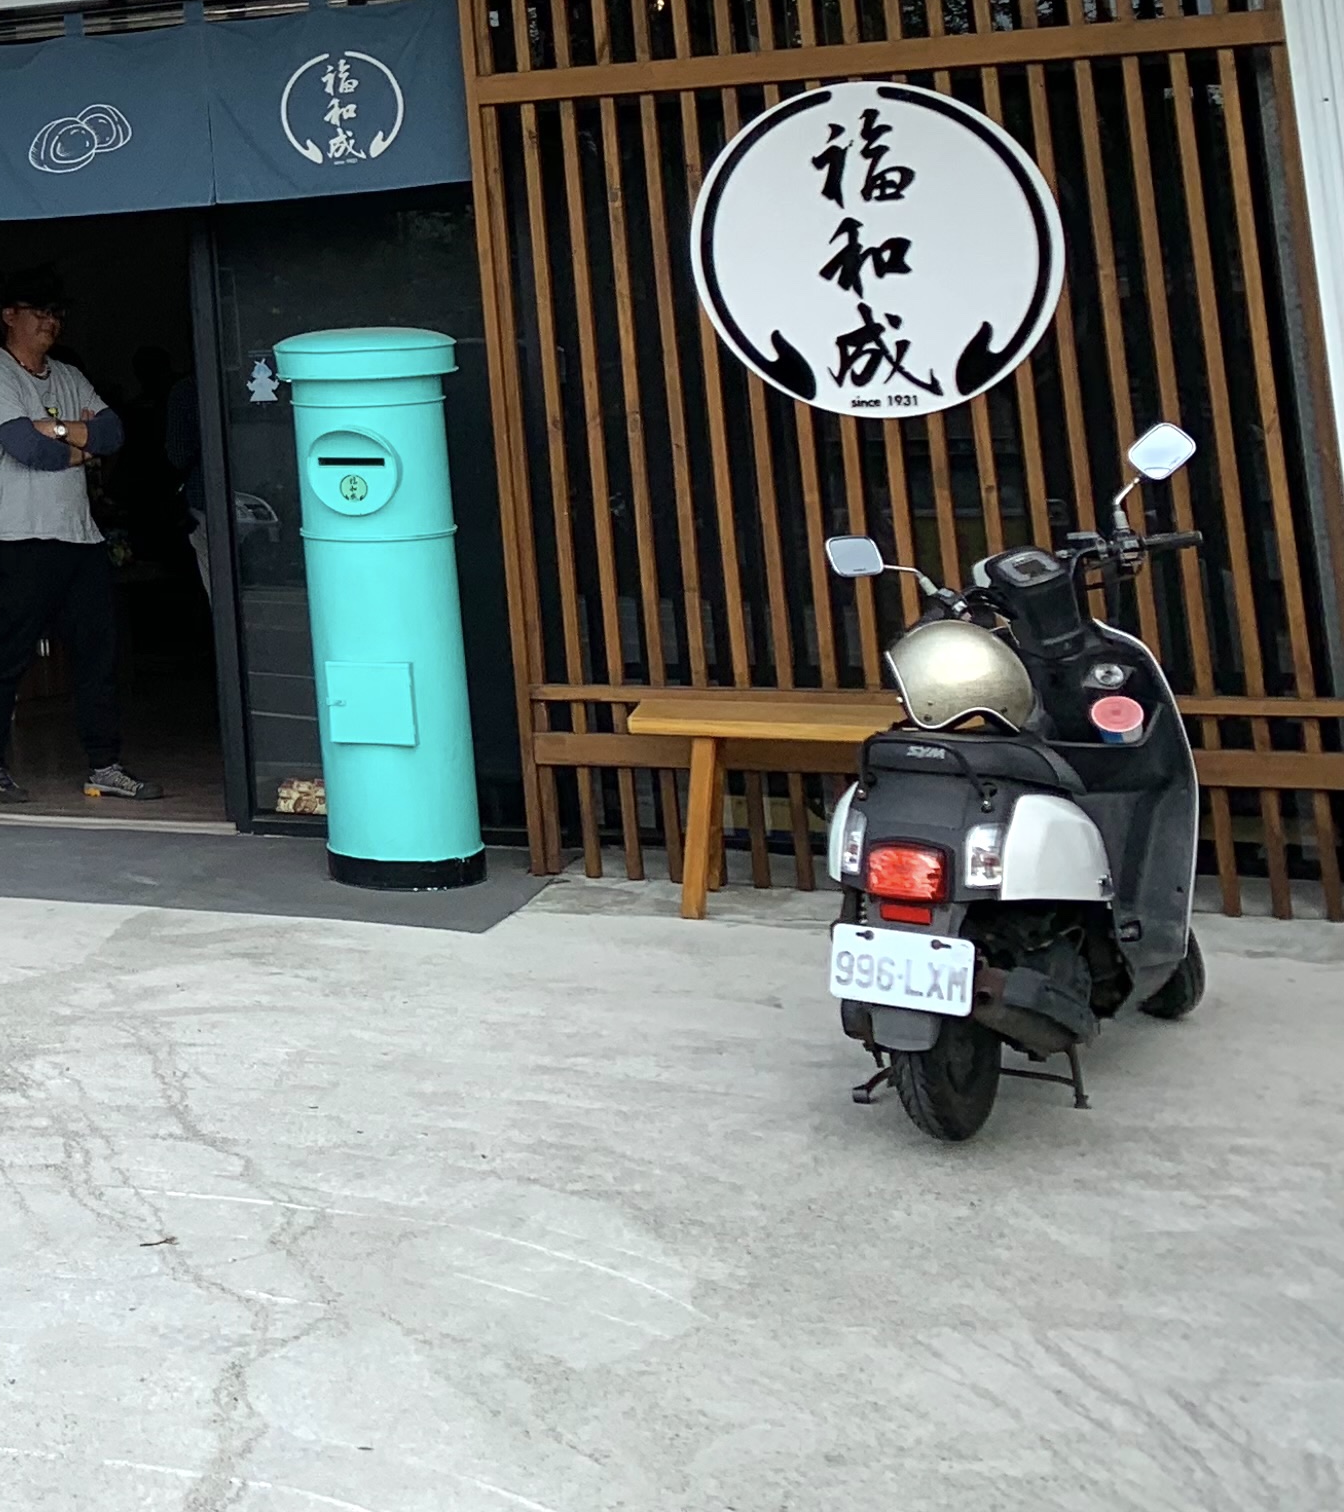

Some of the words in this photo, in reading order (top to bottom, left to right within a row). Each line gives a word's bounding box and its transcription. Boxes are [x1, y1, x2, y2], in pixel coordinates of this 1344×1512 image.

[321, 59, 367, 159] 福和成
[810, 109, 943, 396] 福和成
[851, 395, 881, 407] since
[887, 395, 918, 406] 1931
[906, 746, 945, 760] SYM
